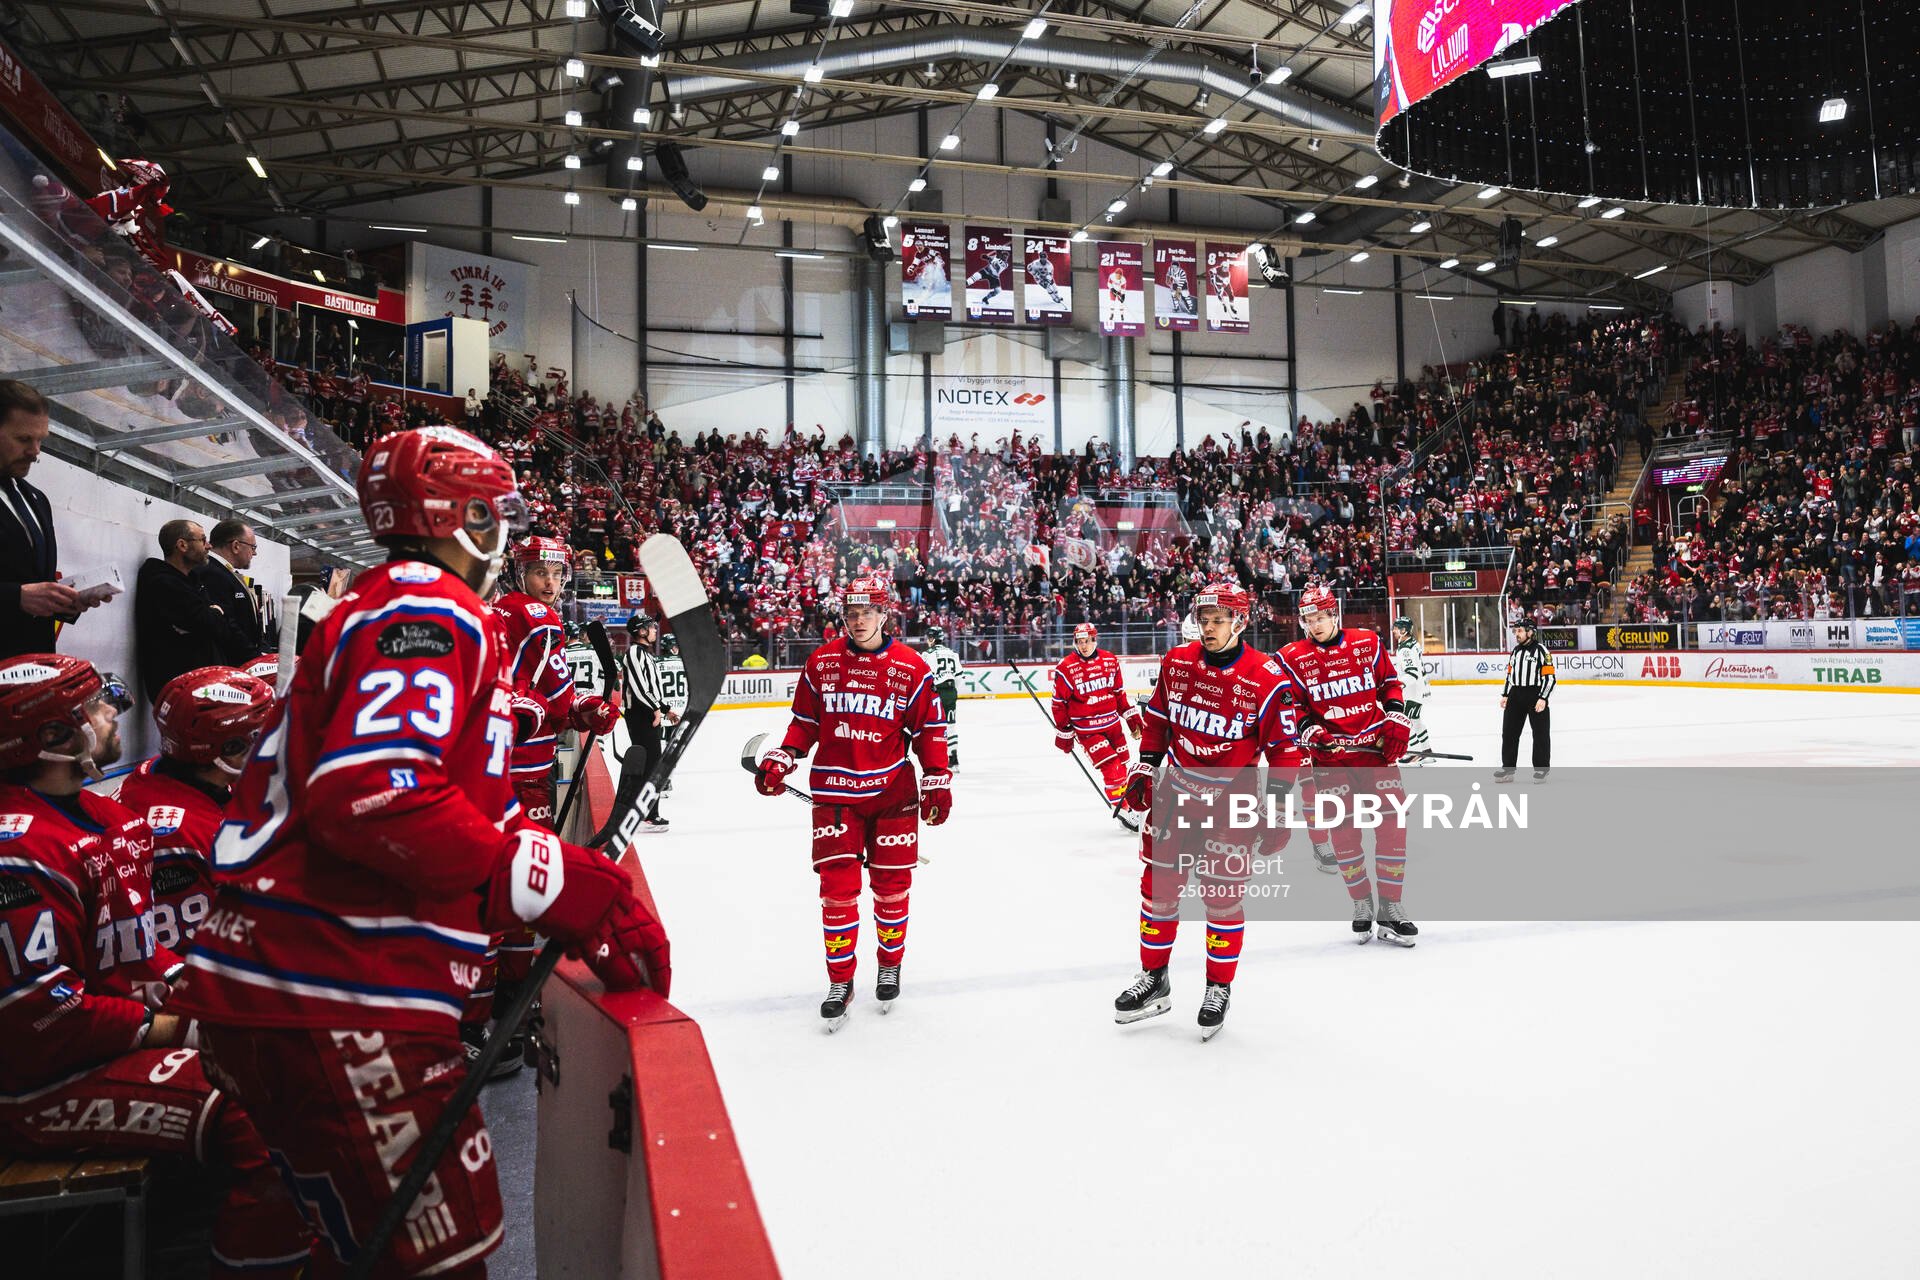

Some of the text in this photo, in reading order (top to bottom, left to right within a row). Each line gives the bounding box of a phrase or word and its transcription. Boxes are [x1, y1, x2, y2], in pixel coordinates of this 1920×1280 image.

[1431, 23, 1469, 78] LILIUM
[967, 238, 979, 251] 8
[1025, 240, 1044, 253] 24
[1100, 253, 1115, 266] 21
[1207, 252, 1217, 265] 8
[450, 264, 506, 292] TIMRÅ IK
[220, 279, 246, 296] KARL
[247, 284, 278, 304] HEDIN
[324, 294, 377, 317] BASTULOGEN
[966, 377, 991, 385] bygger
[993, 377, 1004, 385] för
[938, 388, 1009, 406] NOTEX
[373, 505, 395, 531] 23
[1619, 631, 1669, 644] KERLUND
[1741, 631, 1762, 644] golv
[1827, 625, 1850, 640] HH
[825, 661, 840, 669] SCA
[1304, 659, 1318, 667] SCA
[1556, 656, 1624, 670] HIGHCON
[1641, 656, 1682, 678] ABB
[848, 668, 878, 678] HIGHCON
[897, 671, 912, 682] SCA
[1176, 670, 1190, 678] SCA
[1813, 667, 1882, 683] TIRAB
[661, 670, 686, 698] 26
[1076, 672, 1115, 695] TIMRÅ
[1194, 681, 1224, 695] HIGHCON
[1308, 666, 1376, 702] TIMRÅ
[1241, 688, 1257, 699] SCA
[355, 668, 454, 740] 23
[822, 692, 897, 721] TIMRÅ
[1202, 699, 1221, 709] NHC
[1345, 702, 1374, 717] NHC
[1167, 700, 1245, 740] TIMRÅ
[1279, 709, 1297, 736] 5
[850, 729, 883, 743] NHC
[1089, 739, 1110, 754] coop
[1195, 742, 1233, 756] NHC
[390, 767, 417, 788] ST
[1168, 766, 1224, 798] BILBOLAGE
[527, 805, 551, 821] coo
[876, 832, 917, 848] coop
[152, 893, 210, 950] 89
[0, 909, 59, 976] 14
[26, 1098, 168, 1136] EAB
